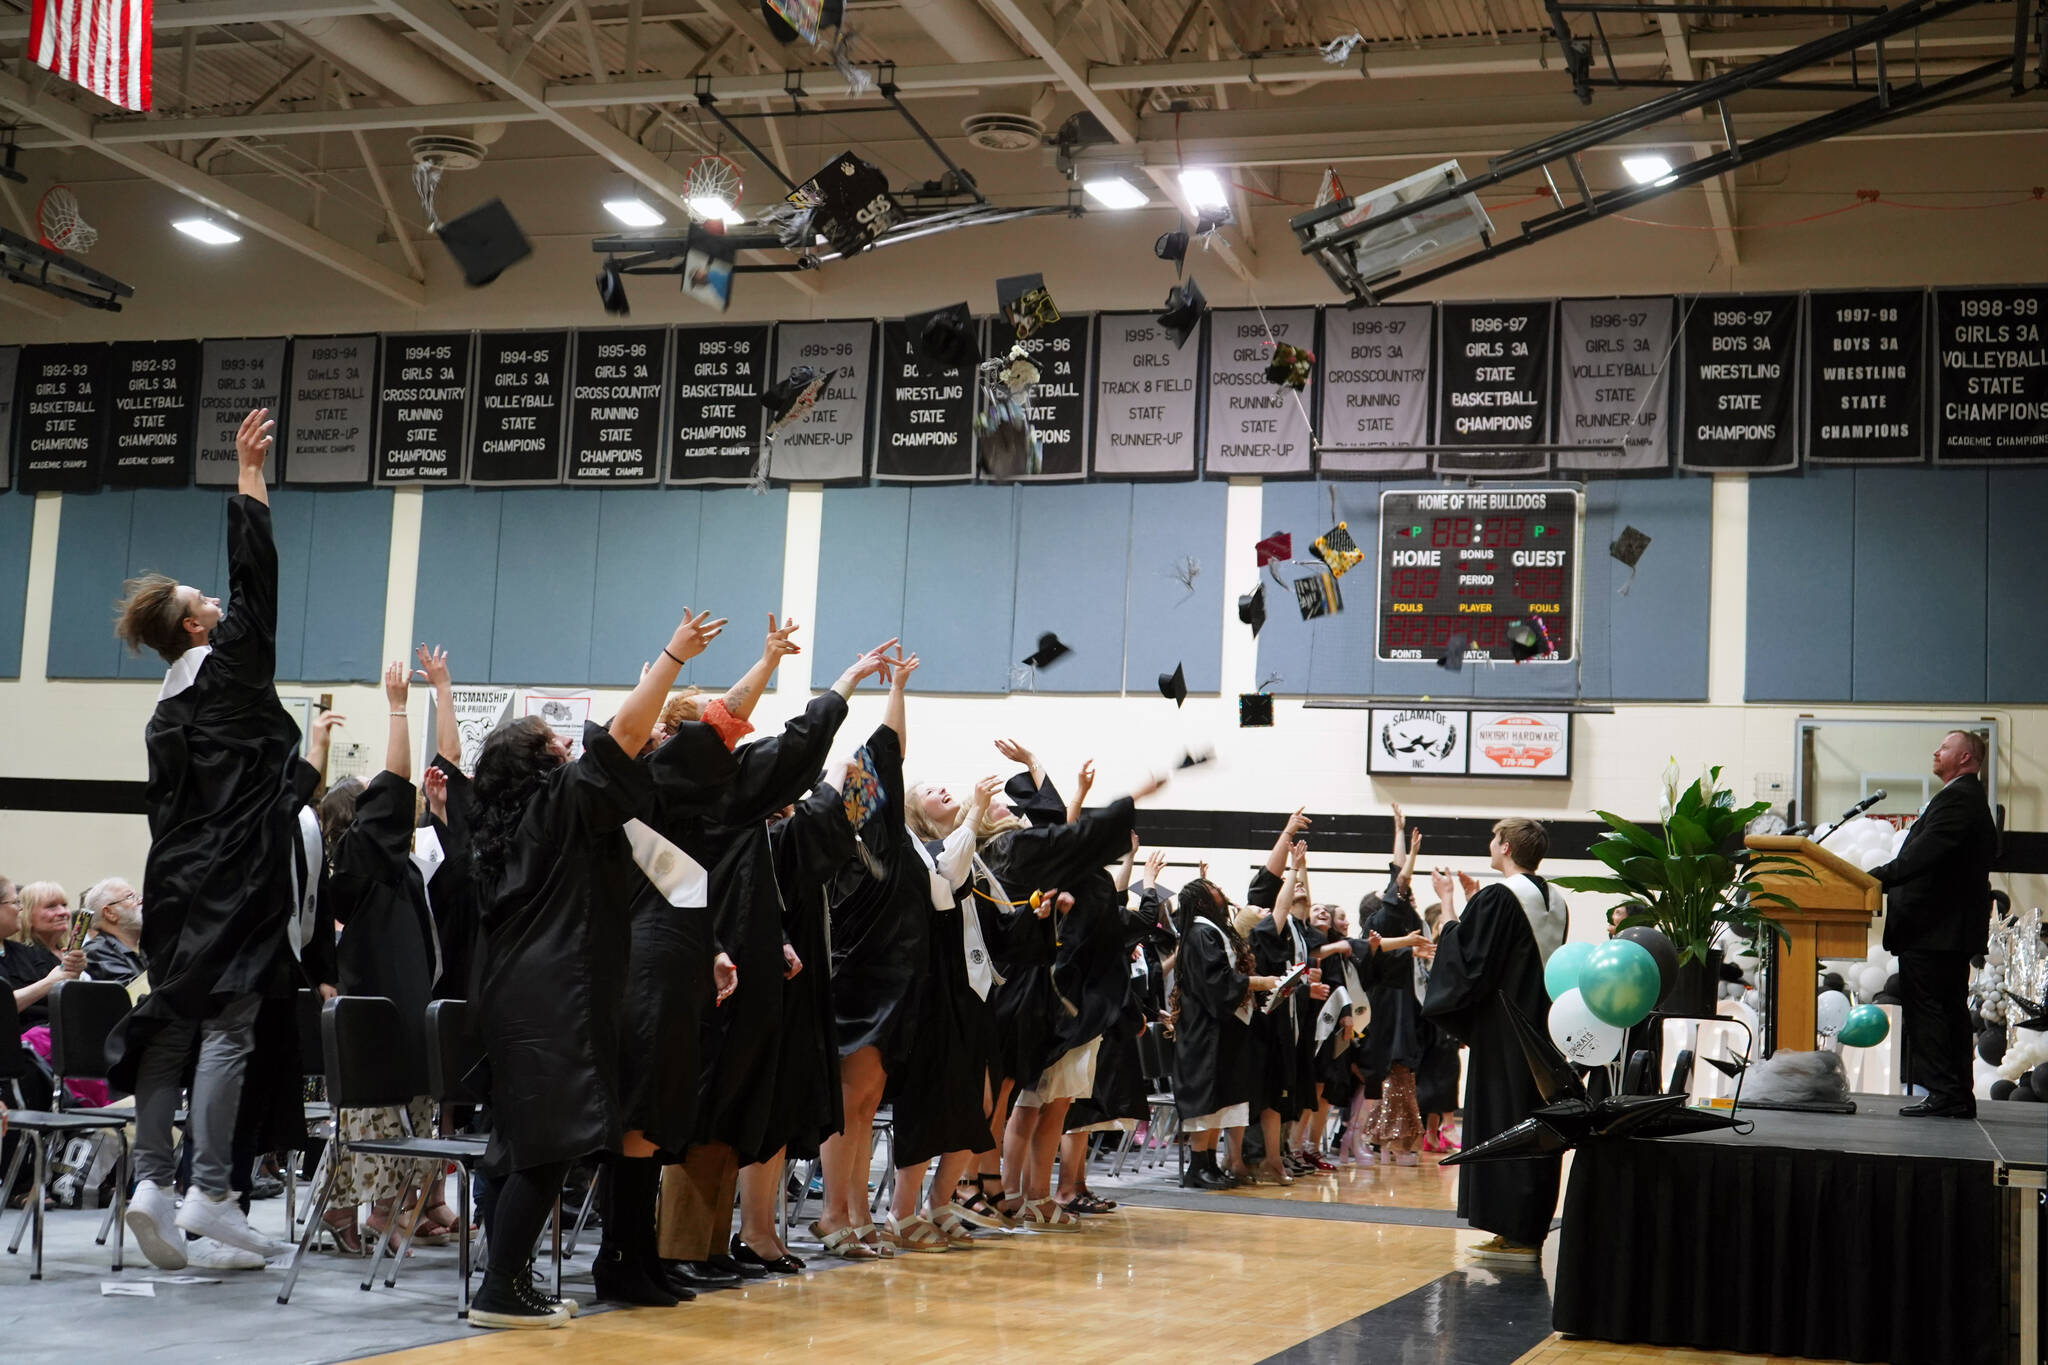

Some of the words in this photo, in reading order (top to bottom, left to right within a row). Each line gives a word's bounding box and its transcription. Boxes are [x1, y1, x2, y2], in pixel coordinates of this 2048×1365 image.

[1836, 308, 1898, 322] 1997-98
[1960, 298, 2038, 318] 1998-99
[1471, 317, 1528, 332] 1996-97
[1590, 312, 1647, 328] 1996-97
[1713, 310, 1773, 326] 1996-97
[1352, 320, 1407, 335] 1996-97
[1955, 325, 2010, 343] GIRLS
[2016, 323, 2039, 342] 3A
[1125, 327, 1174, 343] 1995-9
[598, 344, 647, 358] 1995-96
[699, 341, 750, 355] 1995-96
[1466, 342, 1504, 357] GIRLS
[1511, 341, 1529, 356] 3A
[1585, 338, 1625, 353] GIRLS
[1632, 338, 1650, 352] 3A
[1712, 336, 1747, 352] BOYS
[1753, 336, 1771, 351] 3A
[1833, 337, 1871, 352] BOYS
[1880, 337, 1899, 351] 3A
[312, 347, 358, 361] 1993-94
[405, 346, 452, 360] 1994-95
[500, 350, 550, 364] 1994-95
[1233, 348, 1270, 362] GIRLS
[1351, 345, 1382, 360] BOYS
[1387, 345, 1404, 359] 3A
[1942, 348, 2048, 369] VOLLEYBALL
[131, 358, 177, 373] 1992-93
[221, 358, 264, 371] 1993-94
[1132, 353, 1171, 368] GIRLS
[42, 364, 88, 377] 1992-93
[345, 367, 360, 379] 3A
[401, 367, 433, 380] GIRLS
[439, 367, 455, 380] 3A
[594, 364, 627, 379] GIRLS
[633, 364, 649, 378] 3A
[694, 362, 728, 376] GIRLS
[736, 361, 751, 375] 3A
[839, 365, 855, 379] 3A
[1054, 361, 1071, 375] 3A
[1475, 366, 1516, 381] STATE
[1571, 362, 1658, 378] VOLLEYBALL
[1699, 363, 1781, 380] WRESTLING
[1823, 365, 1907, 381] WRESTLING
[129, 378, 160, 391] GIRLS
[162, 377, 178, 390] 3A
[217, 378, 247, 391] GIRLS
[252, 378, 265, 390] 3A
[494, 372, 528, 386] GIRLS
[534, 372, 550, 385] 3A
[1101, 380, 1141, 394] TRACK
[1155, 378, 1193, 393] FIELD
[1967, 375, 2025, 395] STATE
[36, 383, 67, 396] GIRLS
[78, 382, 92, 395] 3A
[298, 388, 365, 401] BASKETBALL
[382, 388, 417, 402] CROSS
[419, 387, 466, 401] COUNTRY
[574, 386, 609, 400] CROSS
[611, 384, 661, 399] COUNTRY
[681, 383, 757, 398] BASKETBALL
[895, 385, 963, 400] WRESTLING
[1594, 387, 1636, 402] STATE
[116, 395, 185, 410] VOLLEYBALL
[201, 397, 232, 409] CROSS
[484, 395, 555, 409] VOLLEYBALL
[1229, 395, 1284, 410] RUNNING
[1346, 393, 1401, 408] RUNNING
[1452, 390, 1538, 407] BASKETBALL
[1717, 394, 1762, 410] STATE
[1840, 395, 1887, 410] STATE
[29, 400, 96, 414] BASKETBALL
[590, 406, 640, 421] RUNNING
[701, 404, 737, 418] STATE
[1945, 402, 2048, 421] CHAMPIONS
[132, 414, 167, 428] STATE
[216, 412, 249, 424] RUNN
[315, 408, 348, 421] STATE
[398, 408, 444, 421] RUNNING
[909, 409, 946, 424] STATE
[45, 419, 77, 432] STATE
[501, 416, 537, 430] STATE
[1240, 419, 1278, 433] STATE
[1356, 417, 1394, 432] STATE
[1456, 415, 1533, 431] CHAMPIONS
[296, 427, 360, 441] RUNNER-UP
[407, 428, 438, 442] STATE
[599, 428, 632, 442] STATE
[680, 425, 747, 440] CHAMPIONS
[784, 431, 853, 446] RUNNER-UP
[891, 431, 958, 446] CHAMPIONS
[1034, 429, 1071, 444] PIONS
[1697, 424, 1776, 441] CHAMPIONS
[1820, 423, 1910, 440] CHAMPIONS
[31, 438, 89, 451] CHAMPIONS
[118, 433, 178, 447] CHAMPIONS
[482, 438, 546, 454] CHAMPIONS
[1110, 431, 1184, 447] RUNNER-UP
[1947, 435, 1992, 447] ACADEMIC
[387, 449, 447, 463] CHAMPIONS
[580, 449, 643, 463] CHAMPIONS
[720, 446, 750, 456] CHAMPS
[1220, 443, 1295, 457] RUNNER-UP
[615, 467, 644, 476] CHAMPS
[1417, 494, 1449, 510] HOME
[1449, 494, 1465, 510] OF
[1466, 494, 1488, 510] THE
[1489, 494, 1547, 510] BULLDOGS
[1412, 526, 1422, 537] P
[1534, 525, 1545, 537] P
[1391, 550, 1441, 567] HOME
[1459, 549, 1495, 560] BONUS
[1511, 550, 1566, 567] GUEST
[1459, 575, 1495, 585] PERIOD
[1393, 603, 1424, 613] FOULS
[1458, 603, 1493, 613] PLAYER
[1529, 603, 1560, 613] FOULS
[1390, 649, 1422, 660] POINTS
[452, 692, 508, 704] RTSMANSHIP
[467, 705, 497, 714] PRIORITY
[1393, 710, 1446, 726] SALAMATOF
[1479, 731, 1509, 740] NIKISKI
[1512, 731, 1560, 742] HARDWARE
[1412, 759, 1425, 768] INC
